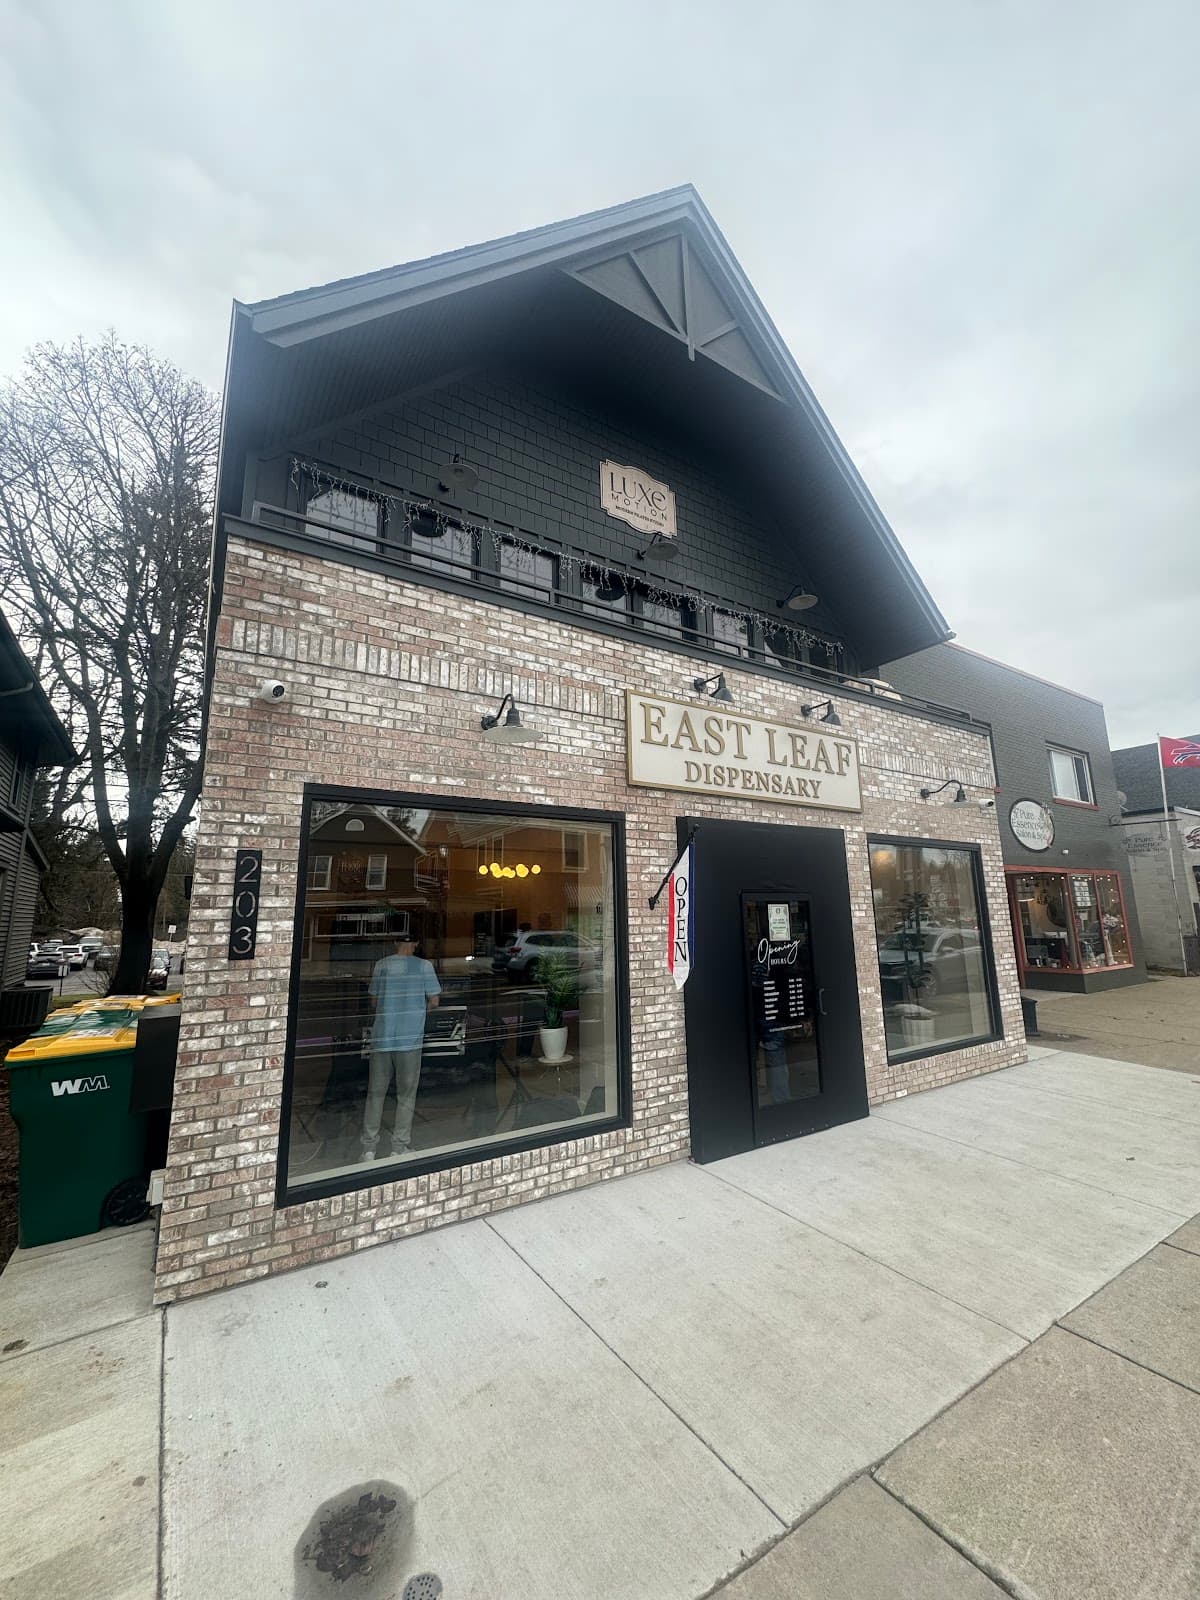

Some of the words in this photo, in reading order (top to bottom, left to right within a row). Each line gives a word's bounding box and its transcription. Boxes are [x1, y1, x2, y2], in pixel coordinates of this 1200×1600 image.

[612, 493, 668, 520] MOTION
[640, 701, 751, 760] EAST
[765, 728, 852, 776] LEAF
[685, 760, 822, 799] DISPENSARY
[233, 856, 258, 954] 203
[674, 876, 688, 962] OPEN
[758, 938, 800, 975] Opening
[51, 1075, 110, 1097] WM
